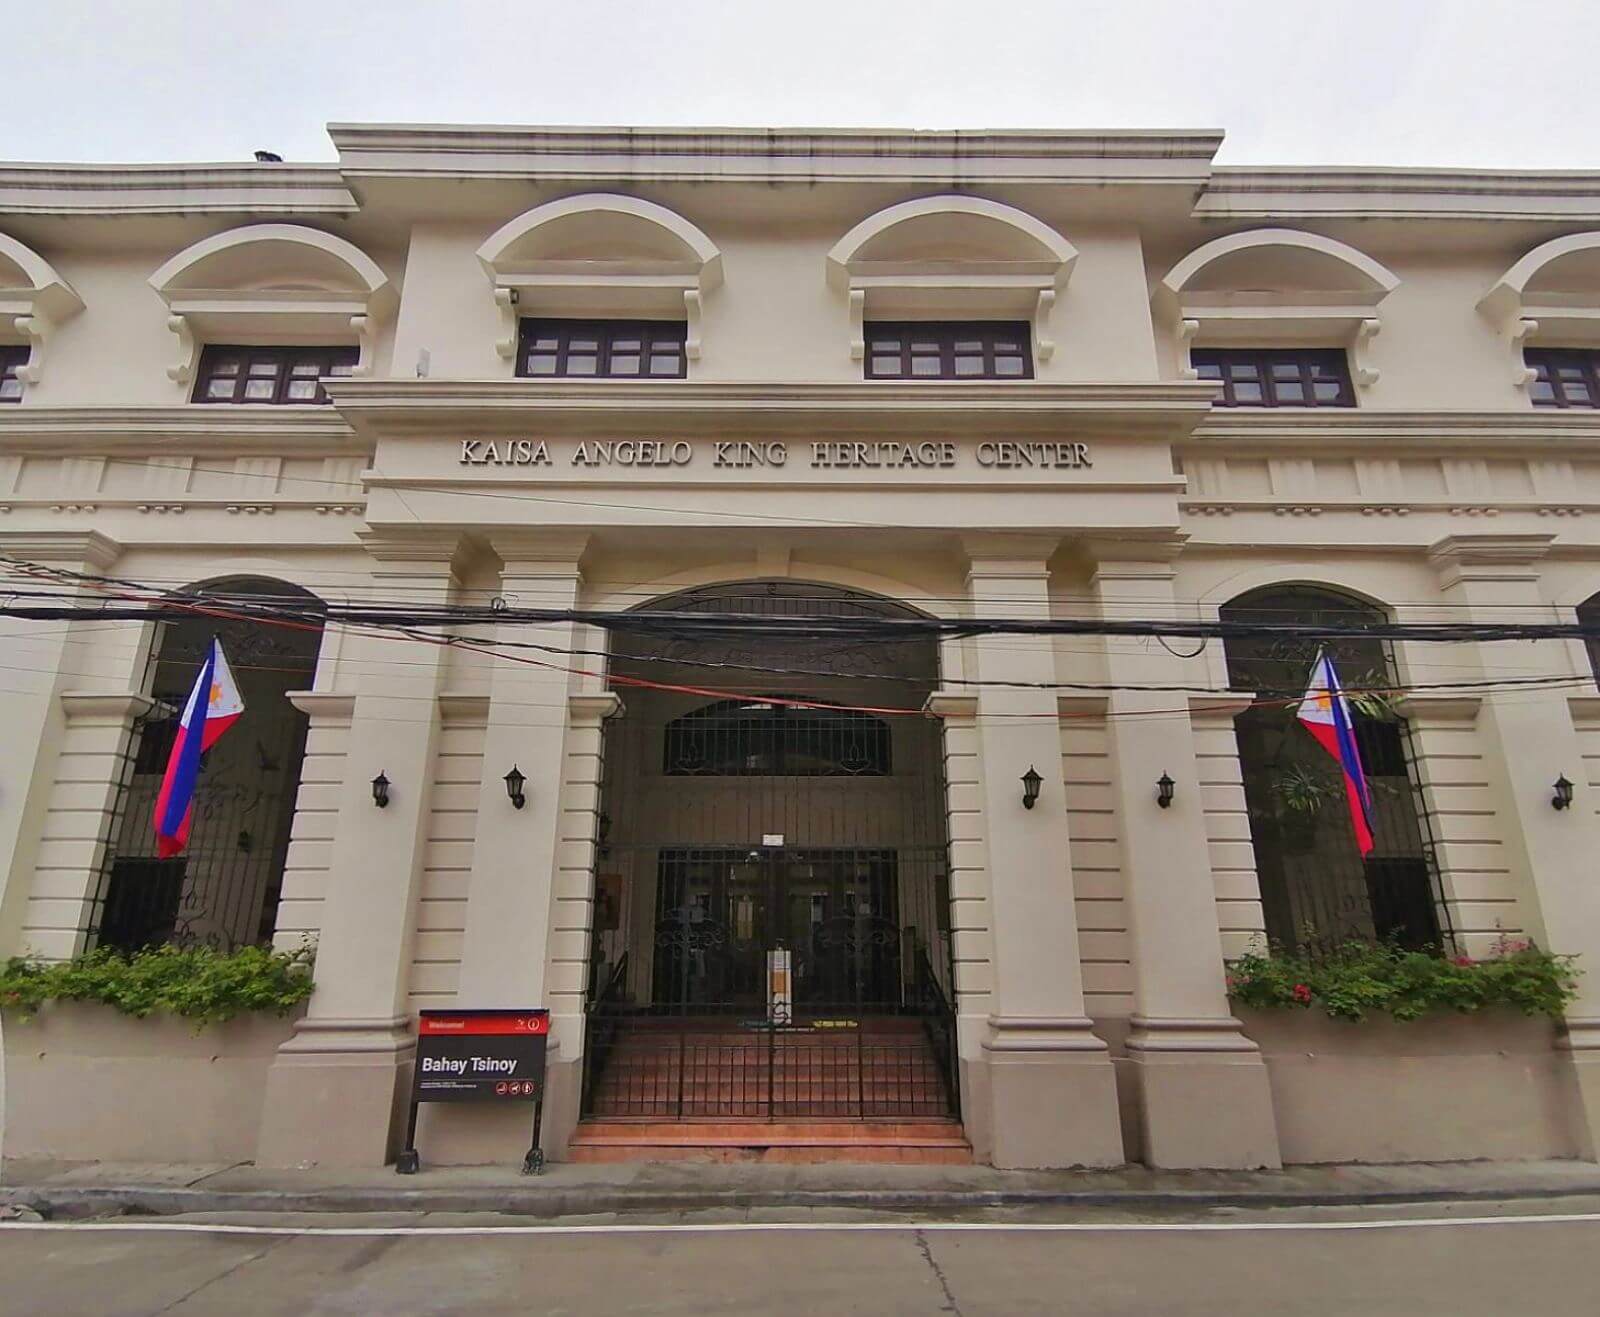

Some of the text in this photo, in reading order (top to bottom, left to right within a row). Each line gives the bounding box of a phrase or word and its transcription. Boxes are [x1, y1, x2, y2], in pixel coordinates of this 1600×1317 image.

[459, 440, 1092, 468] KAISA ANGELO KING HERITAGE CENTER
[422, 1057, 517, 1075] Bahay Tsinoy
